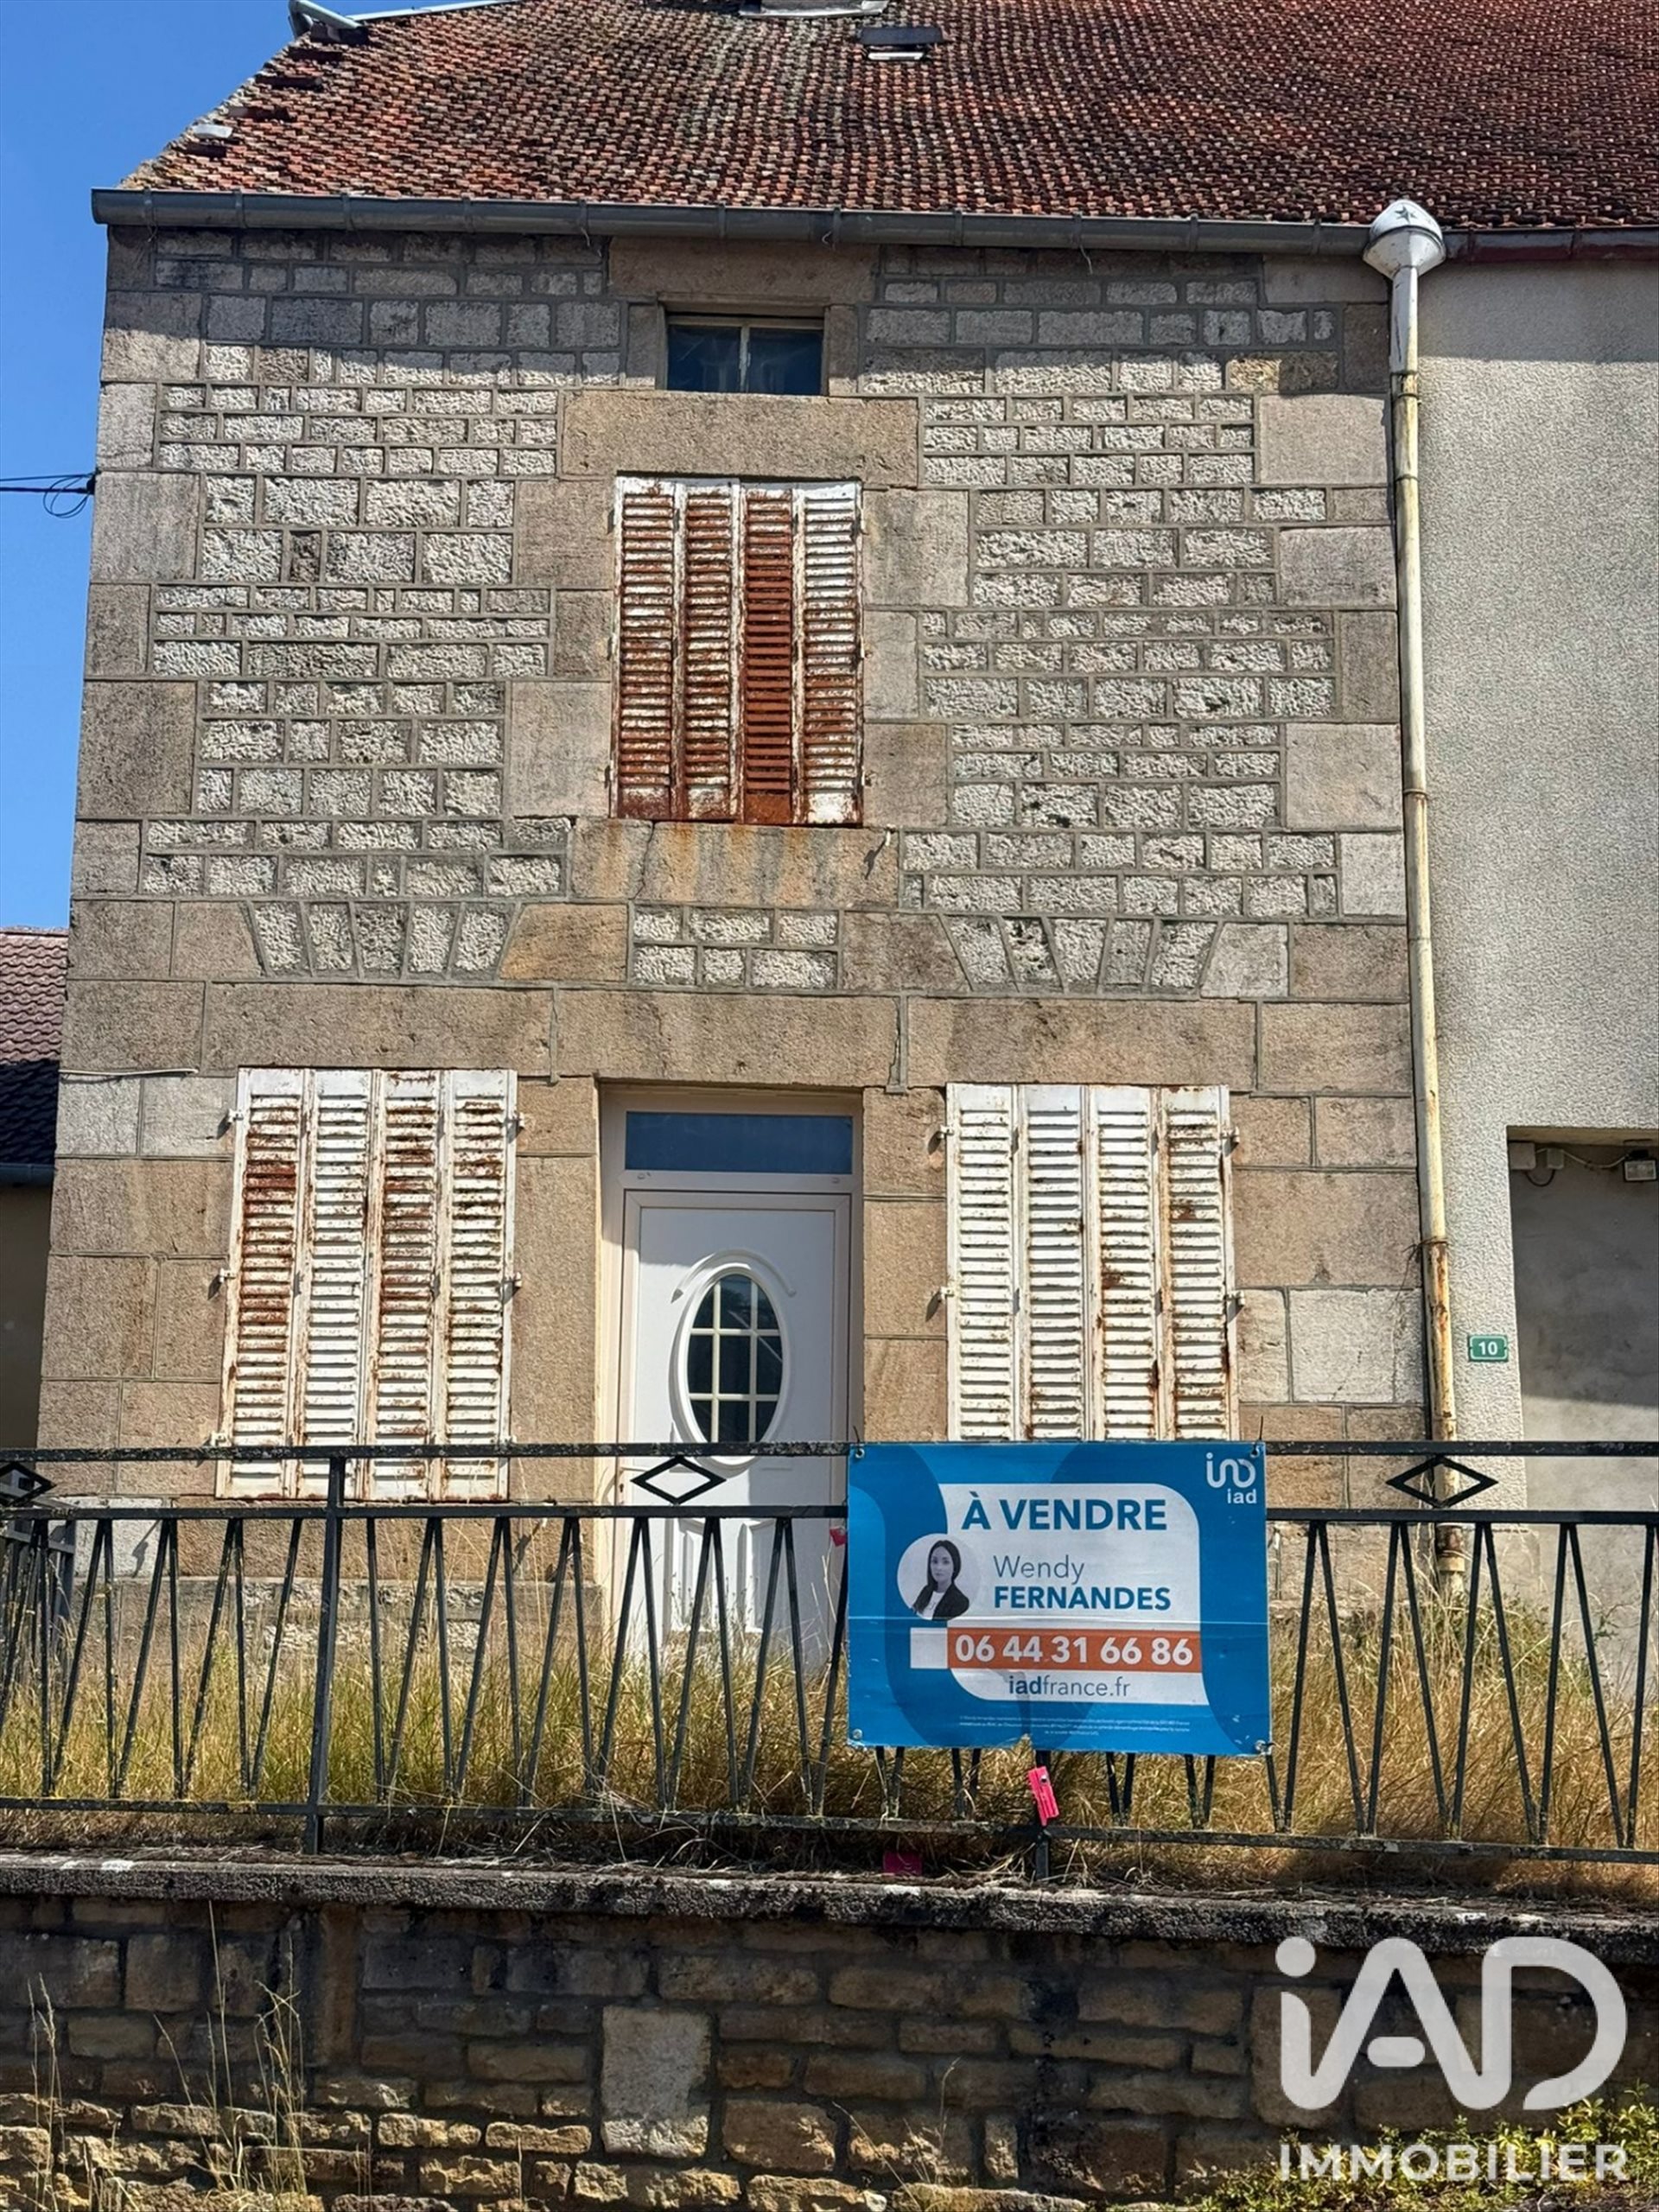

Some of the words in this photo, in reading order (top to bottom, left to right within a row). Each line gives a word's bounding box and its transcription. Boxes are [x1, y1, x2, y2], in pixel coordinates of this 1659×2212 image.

[1478, 1341, 1498, 1356] 10
[1227, 1488, 1257, 1504] iad
[961, 1491, 992, 1530] À
[999, 1499, 1167, 1531] VENDRE
[994, 1554, 1085, 1585] Wendy
[995, 1586, 1172, 1611] FERNANDES
[955, 1634, 995, 1663] 06
[1002, 1635, 1044, 1663] 44
[1051, 1636, 1088, 1663] 31
[1100, 1637, 1143, 1665] 66
[1151, 1637, 1193, 1667] 86
[1009, 1675, 1132, 1697] iadfrance.fr
